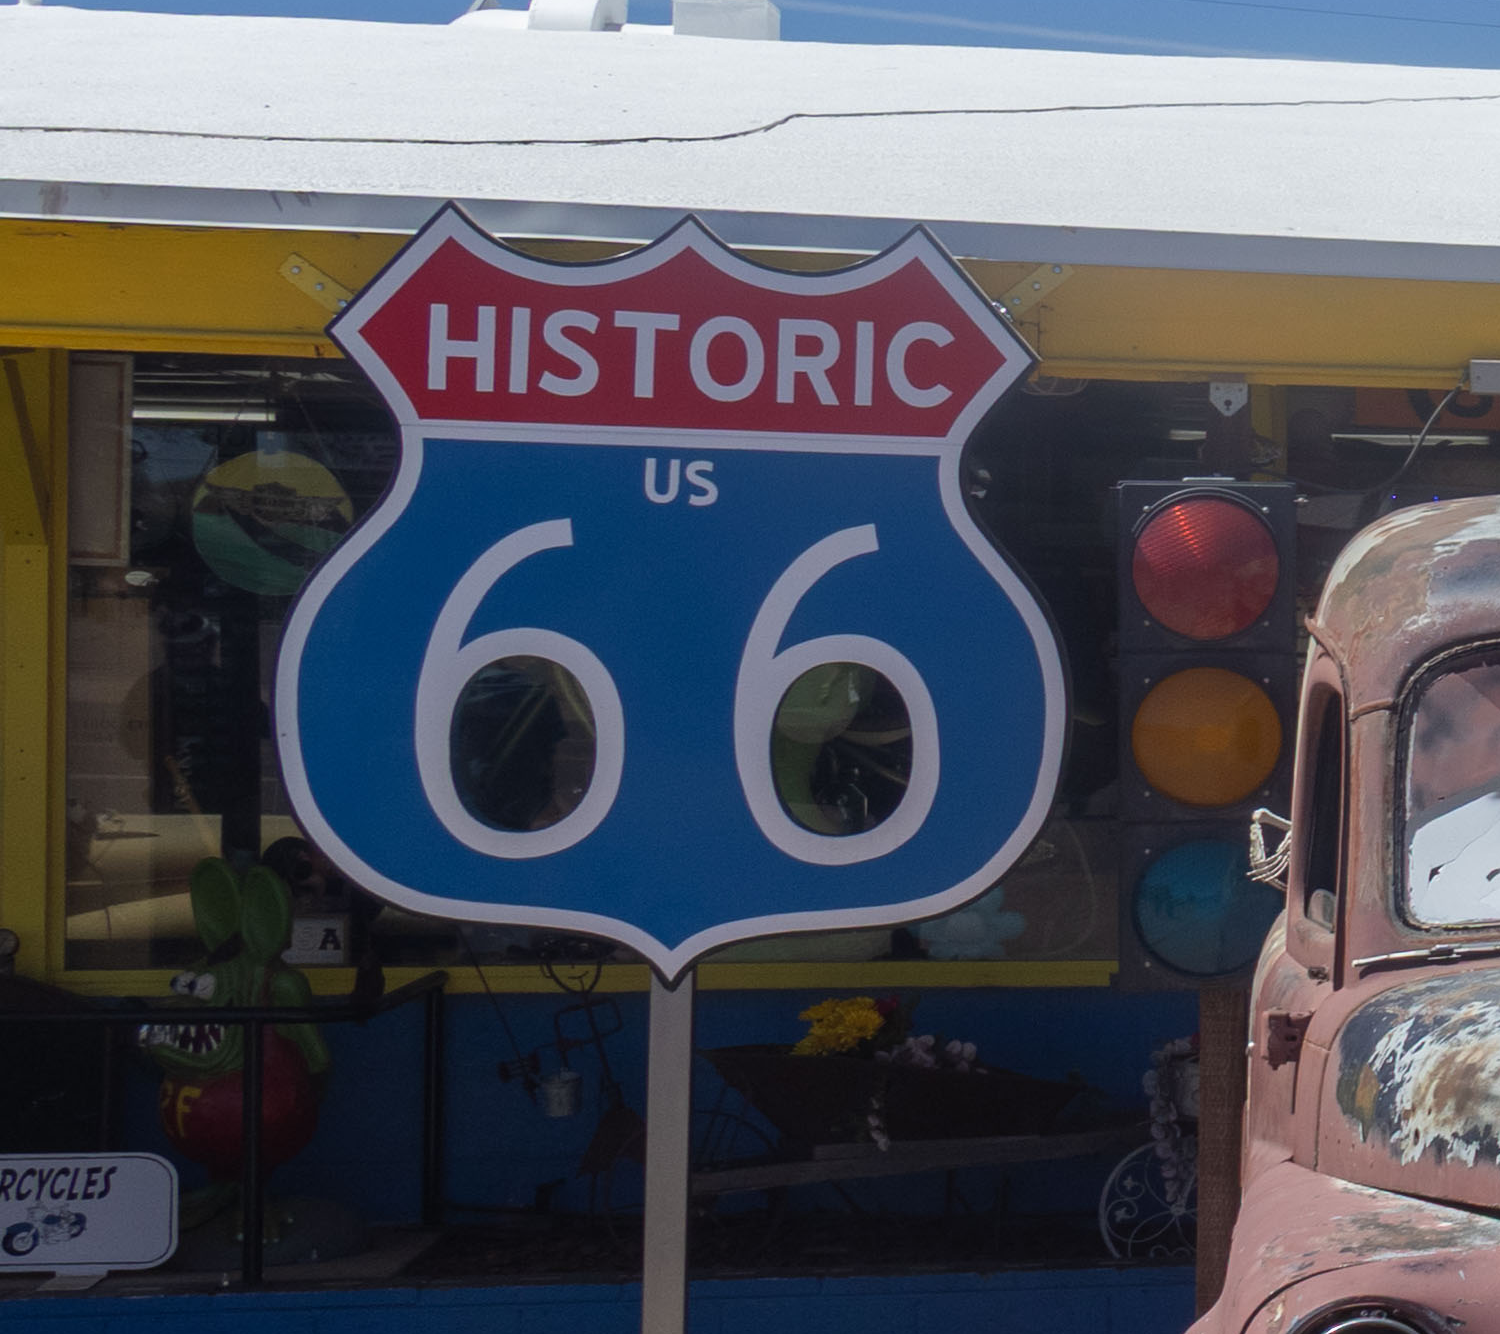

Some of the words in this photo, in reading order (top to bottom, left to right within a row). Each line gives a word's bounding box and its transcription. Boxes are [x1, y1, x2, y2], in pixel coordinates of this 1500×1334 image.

[427, 303, 955, 409] HISTORIC
[643, 457, 719, 506] US
[414, 517, 940, 865] 66
